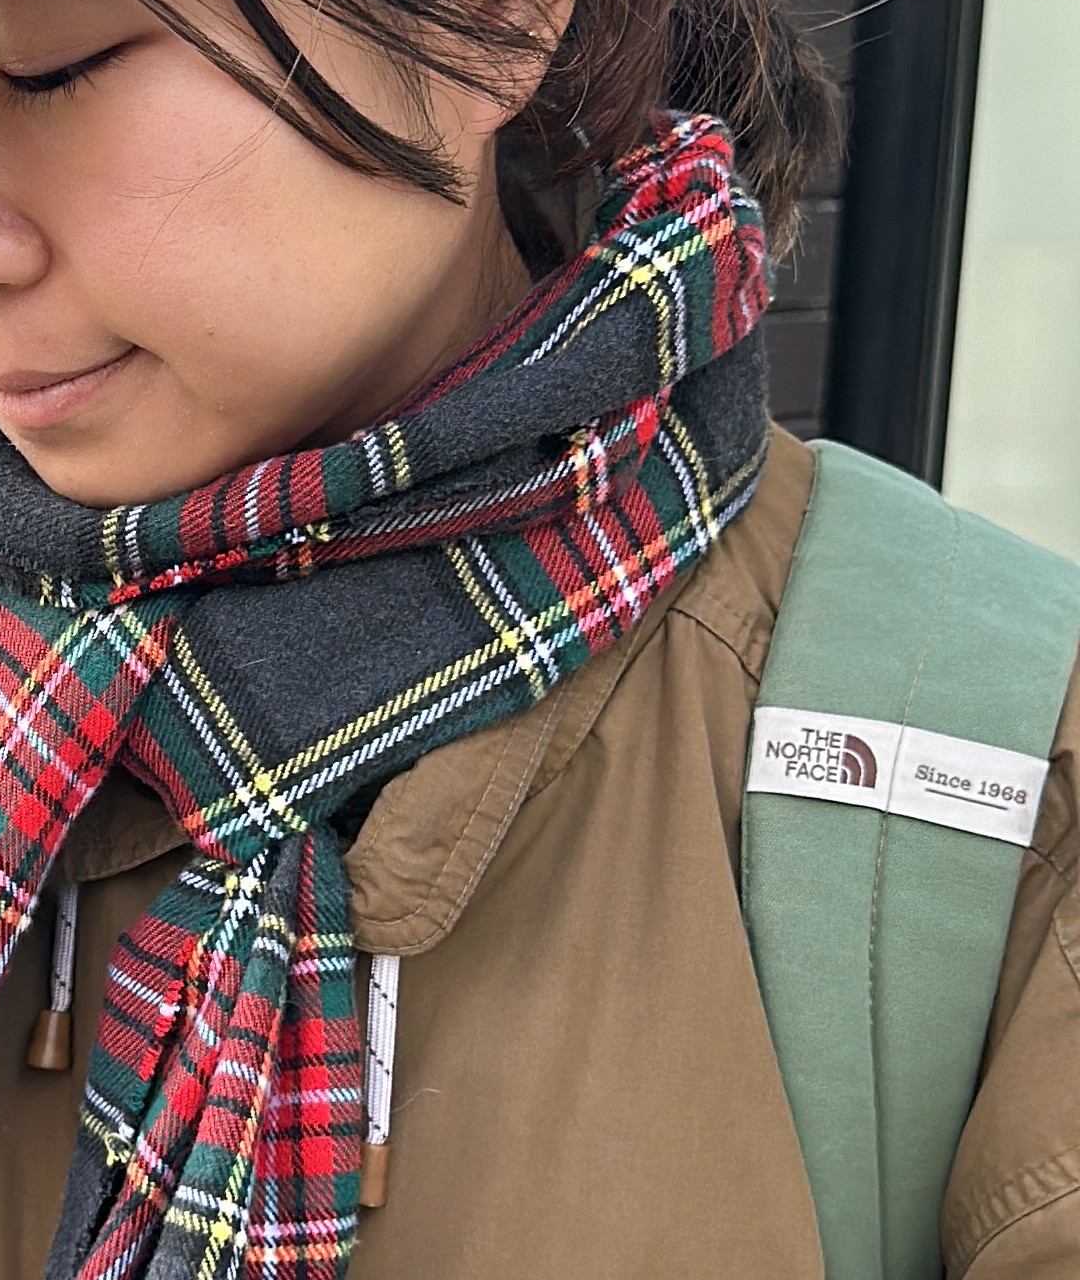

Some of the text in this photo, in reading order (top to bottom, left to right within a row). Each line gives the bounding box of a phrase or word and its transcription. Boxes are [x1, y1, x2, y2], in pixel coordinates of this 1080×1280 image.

[801, 727, 843, 749] THE
[765, 740, 842, 766] NORTH
[784, 760, 838, 784] FACE
[914, 764, 1027, 806] Since 1968
